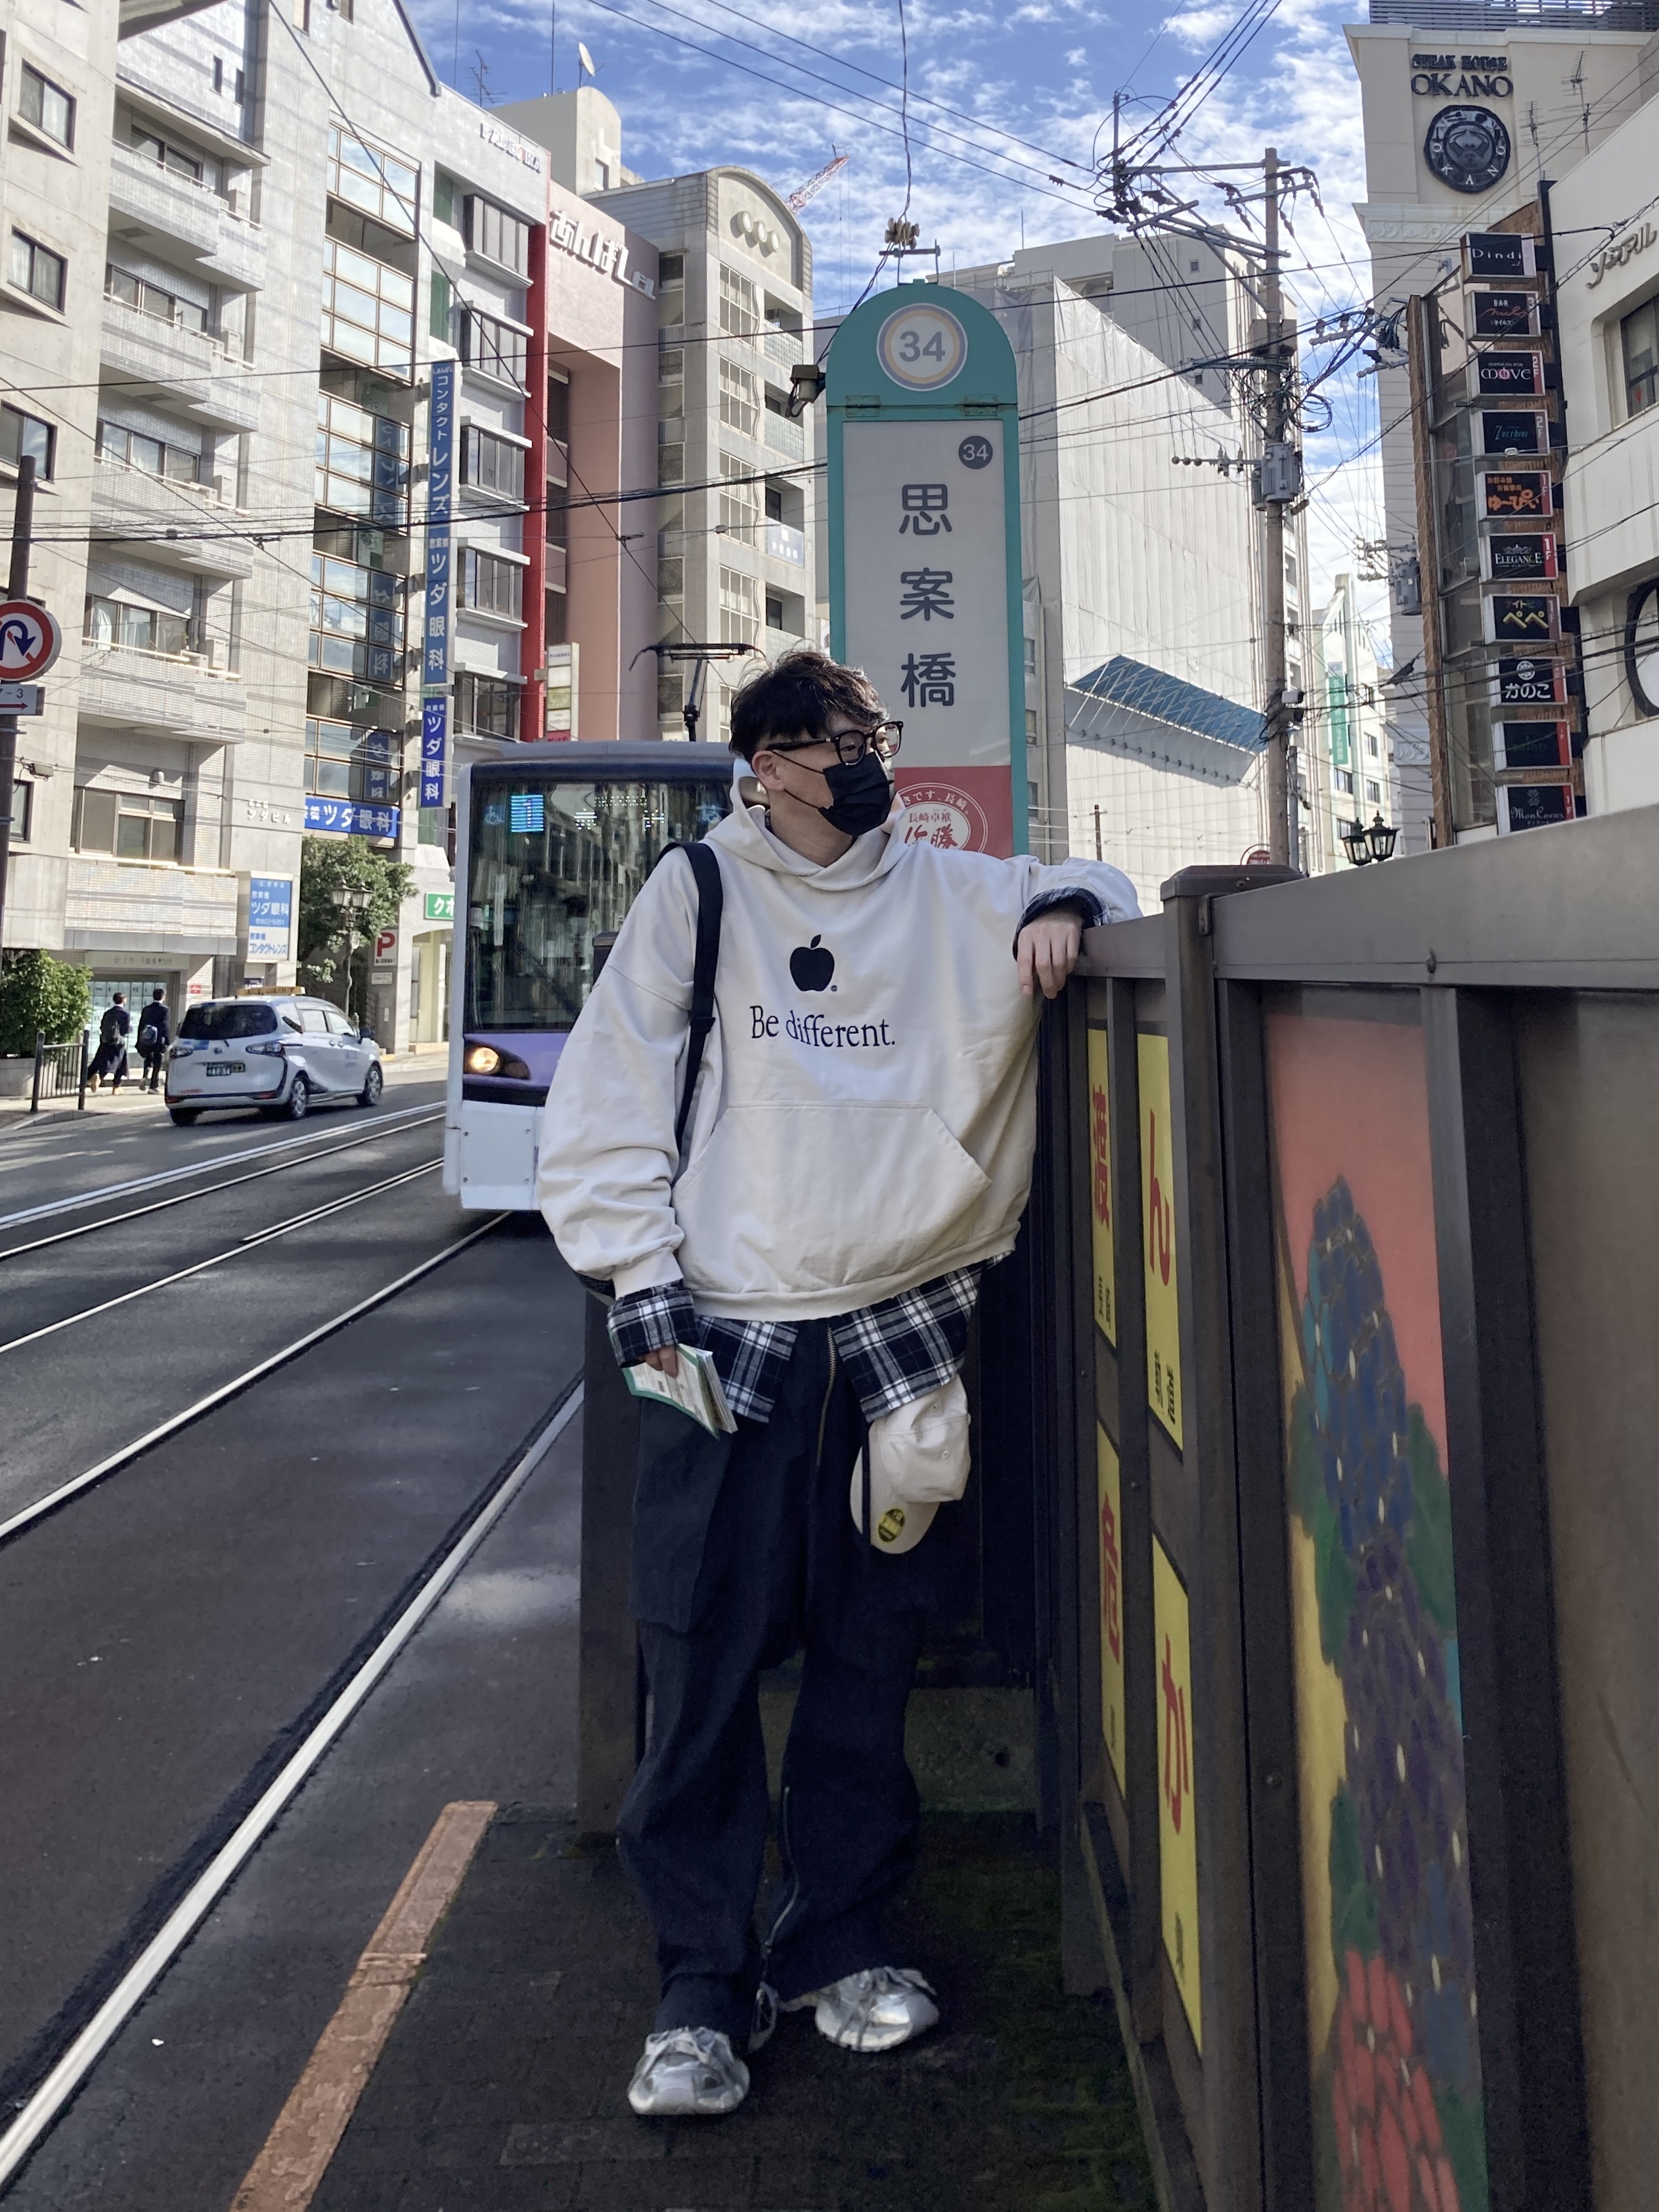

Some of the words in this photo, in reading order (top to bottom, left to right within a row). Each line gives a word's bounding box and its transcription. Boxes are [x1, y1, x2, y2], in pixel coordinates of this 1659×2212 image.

[1413, 54, 1456, 70] STEAK
[1461, 55, 1508, 71] HOUSE
[1411, 73, 1513, 97] OKANO
[1472, 248, 1522, 259] Dindi
[899, 330, 946, 363] 34
[430, 376, 451, 515] コンタクトレンズ
[963, 444, 988, 460] 34
[1495, 552, 1542, 564] ELEGANCE
[898, 483, 956, 708] 思案橋
[428, 553, 447, 671] ツダ眼科
[1505, 683, 1551, 699] かのこ
[424, 716, 443, 801] ツダ眼科
[324, 804, 389, 833] ツダ眼科
[251, 901, 289, 916] ツダ眼科
[249, 942, 287, 954] コンタクトレンズ
[377, 933, 396, 957] P
[750, 1006, 779, 1039] Be
[785, 1009, 895, 1048] different.
[1149, 1108, 1170, 1286] ん
[1161, 1633, 1189, 1835] か
